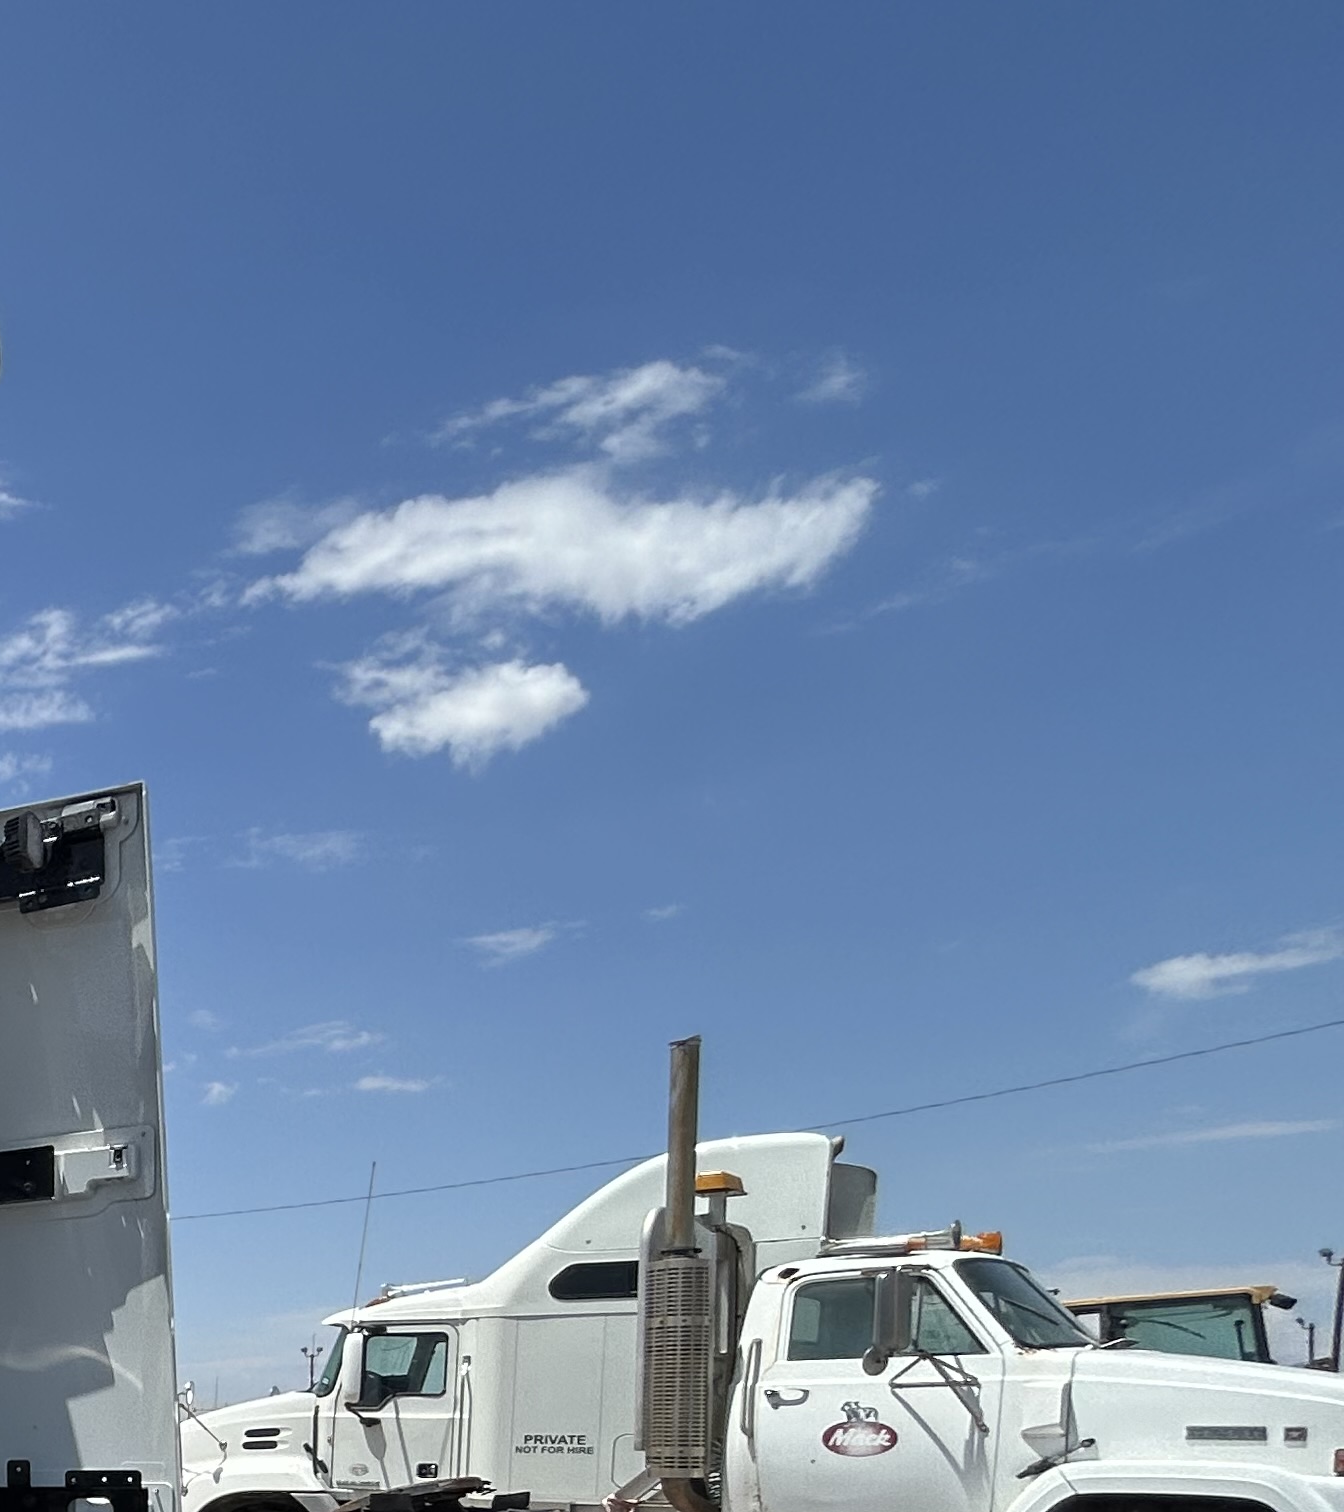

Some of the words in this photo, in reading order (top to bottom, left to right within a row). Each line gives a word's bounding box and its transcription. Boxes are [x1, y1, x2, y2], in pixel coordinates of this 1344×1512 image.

[523, 1434, 587, 1446] PRIVATE
[827, 1428, 892, 1447] Mack
[514, 1445, 538, 1455] NOT
[540, 1445, 565, 1455] FOR
[566, 1446, 595, 1456] HIRE
